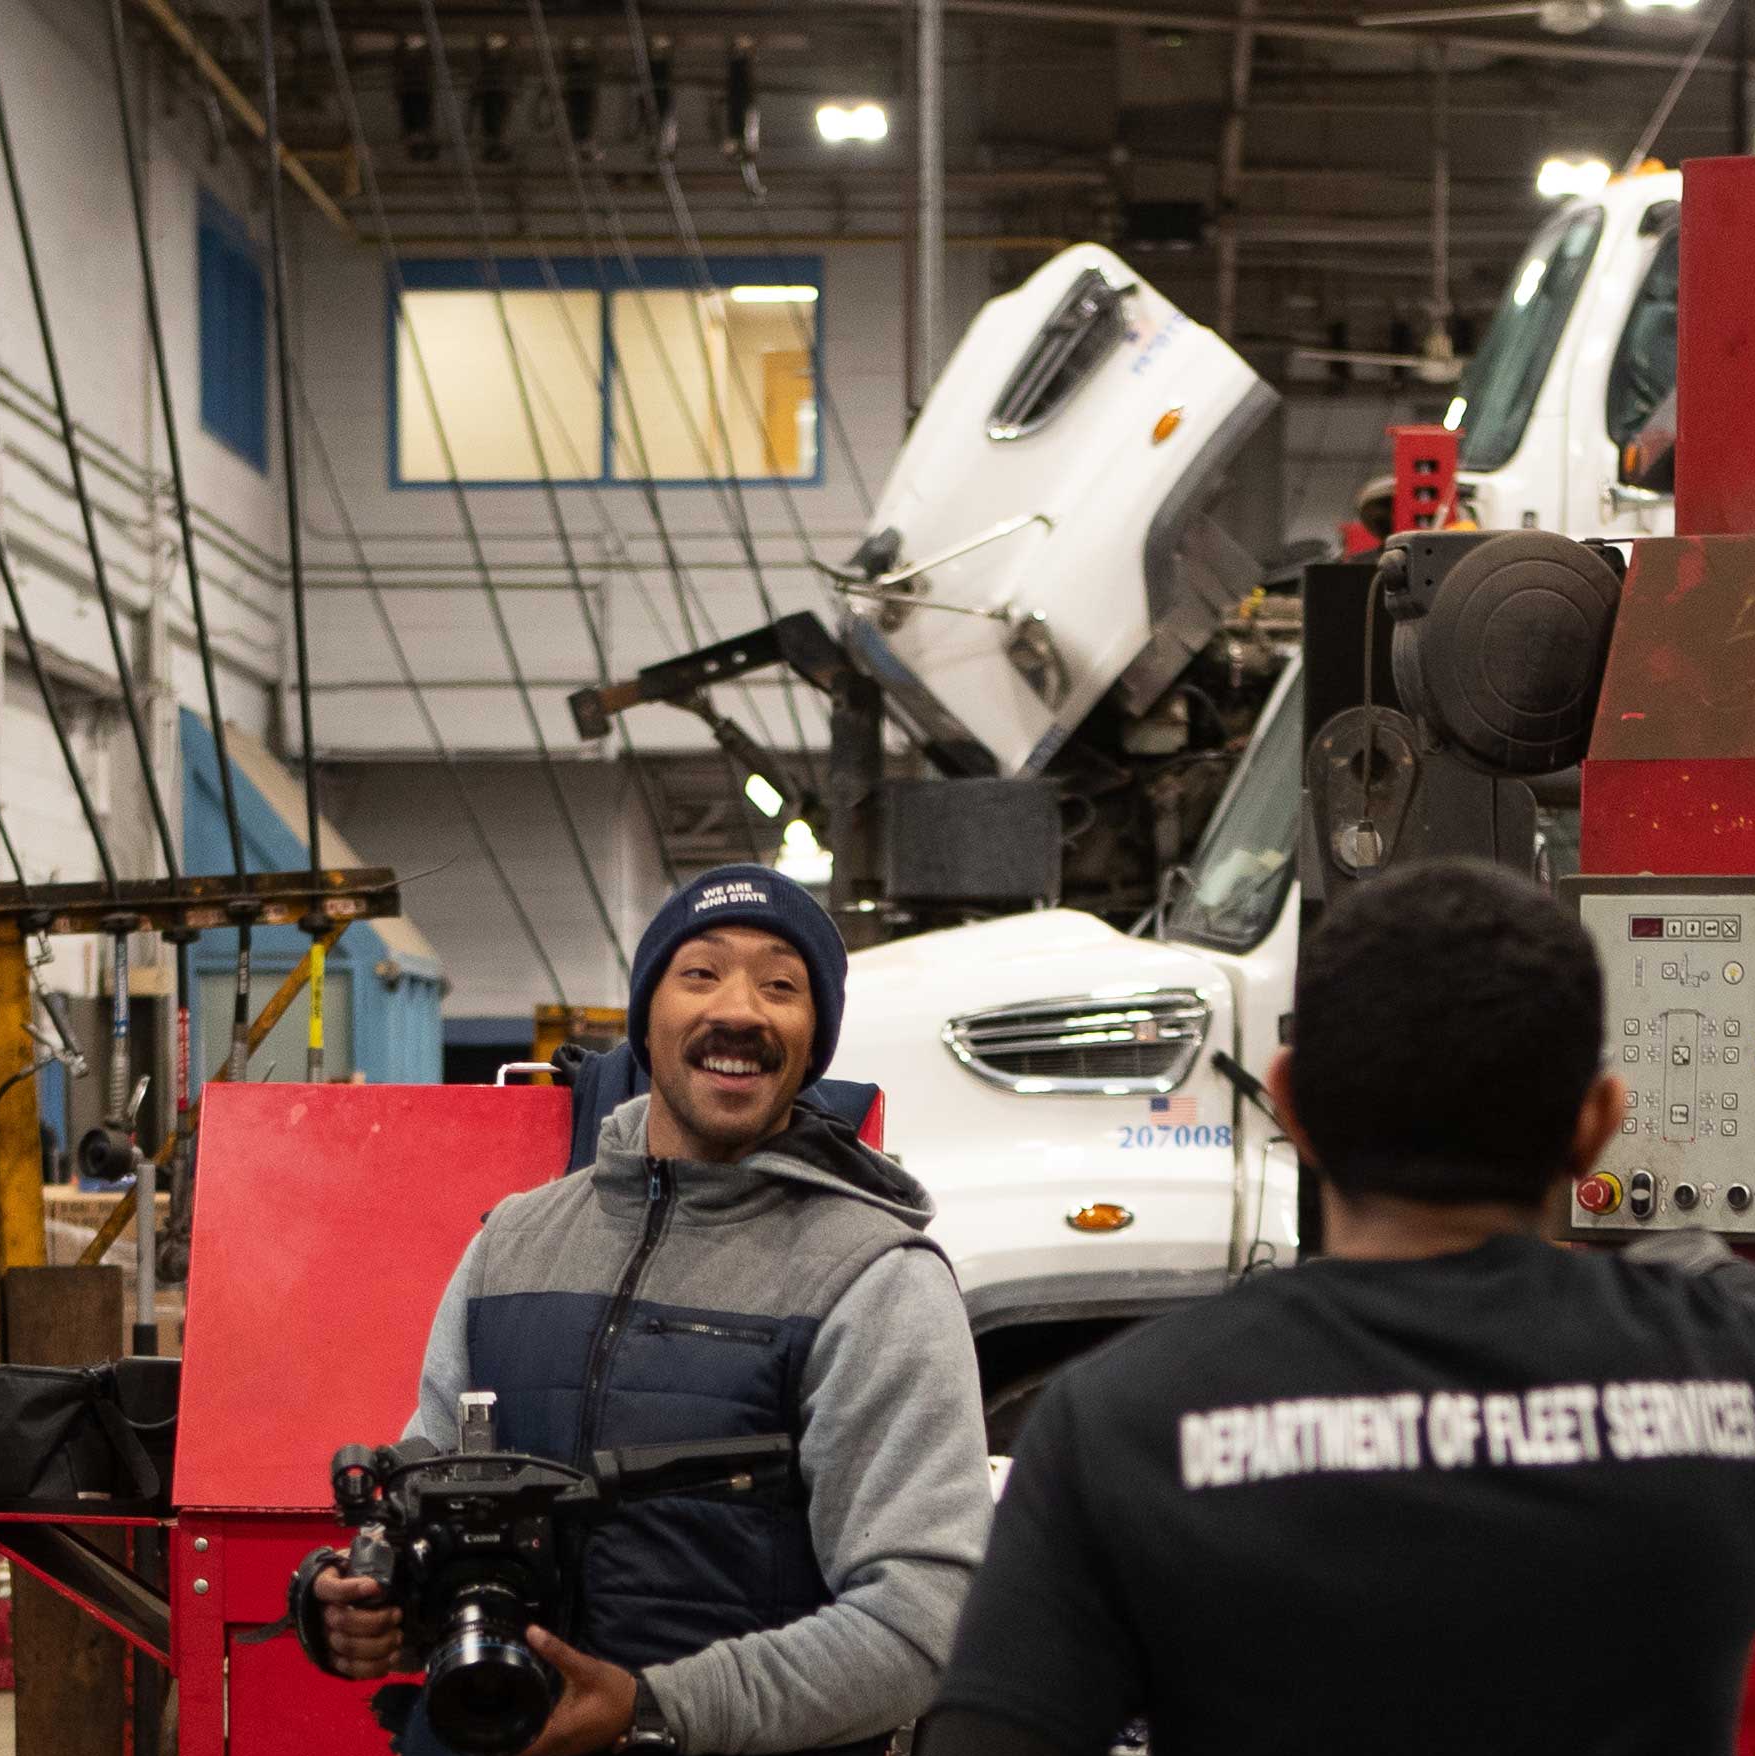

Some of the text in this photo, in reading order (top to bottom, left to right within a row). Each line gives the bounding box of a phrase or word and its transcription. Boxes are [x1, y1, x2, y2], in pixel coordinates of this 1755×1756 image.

[703, 882, 753, 900] WE ARE
[694, 892, 768, 913] PENN STATE
[1118, 1124, 1234, 1149] 207008
[1179, 1393, 1423, 1490] DEPARTMENT
[1427, 1389, 1480, 1469] OF
[1485, 1383, 1600, 1466] FLEET
[463, 1533, 501, 1544] Canon
